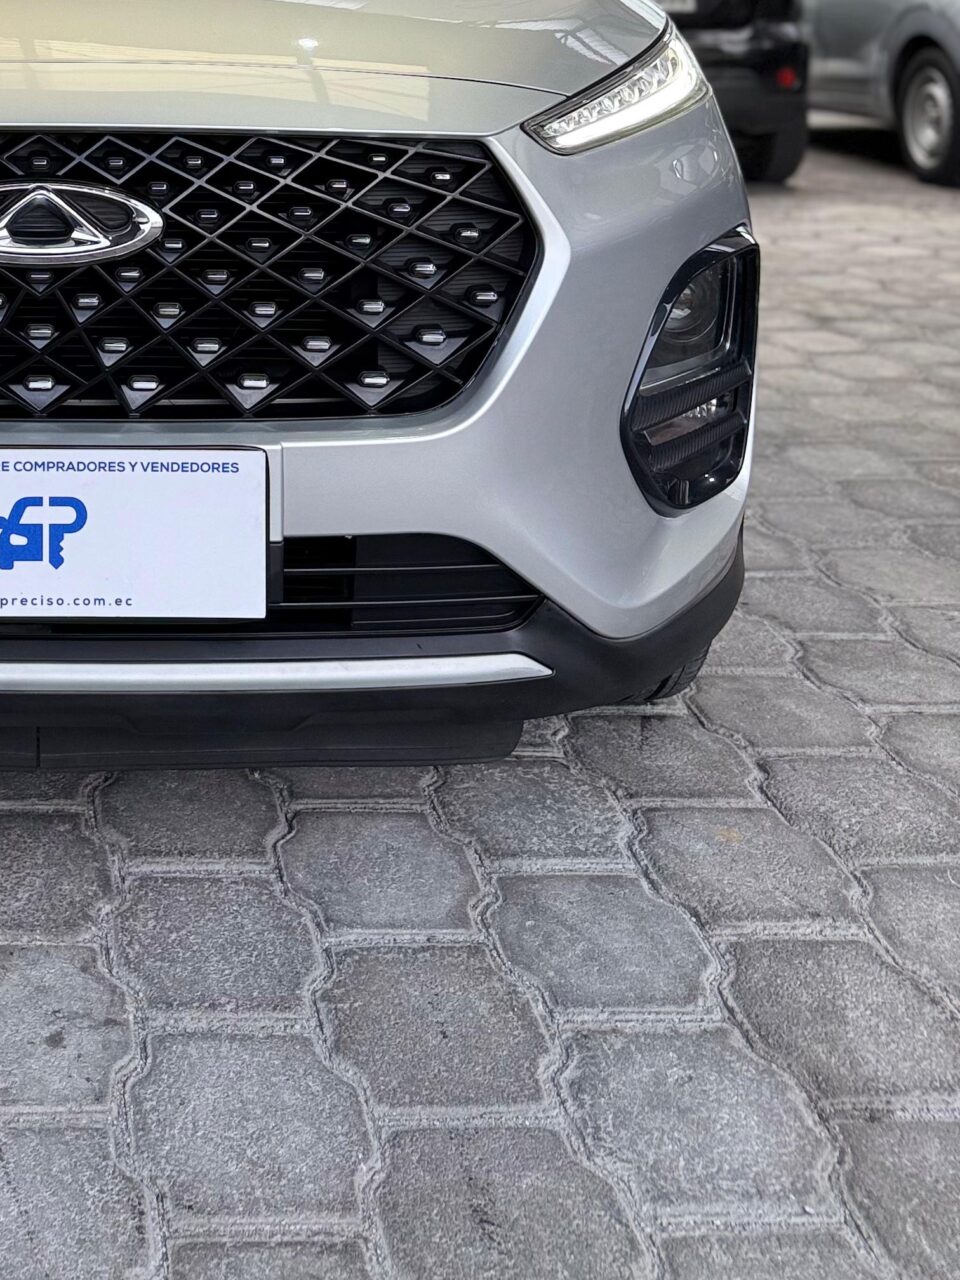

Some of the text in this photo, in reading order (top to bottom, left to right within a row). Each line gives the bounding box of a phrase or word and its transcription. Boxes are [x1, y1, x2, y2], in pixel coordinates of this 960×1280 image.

[13, 461, 126, 473] COMPRADORES
[128, 461, 138, 473] Y
[140, 461, 240, 474] VENDEDORES
